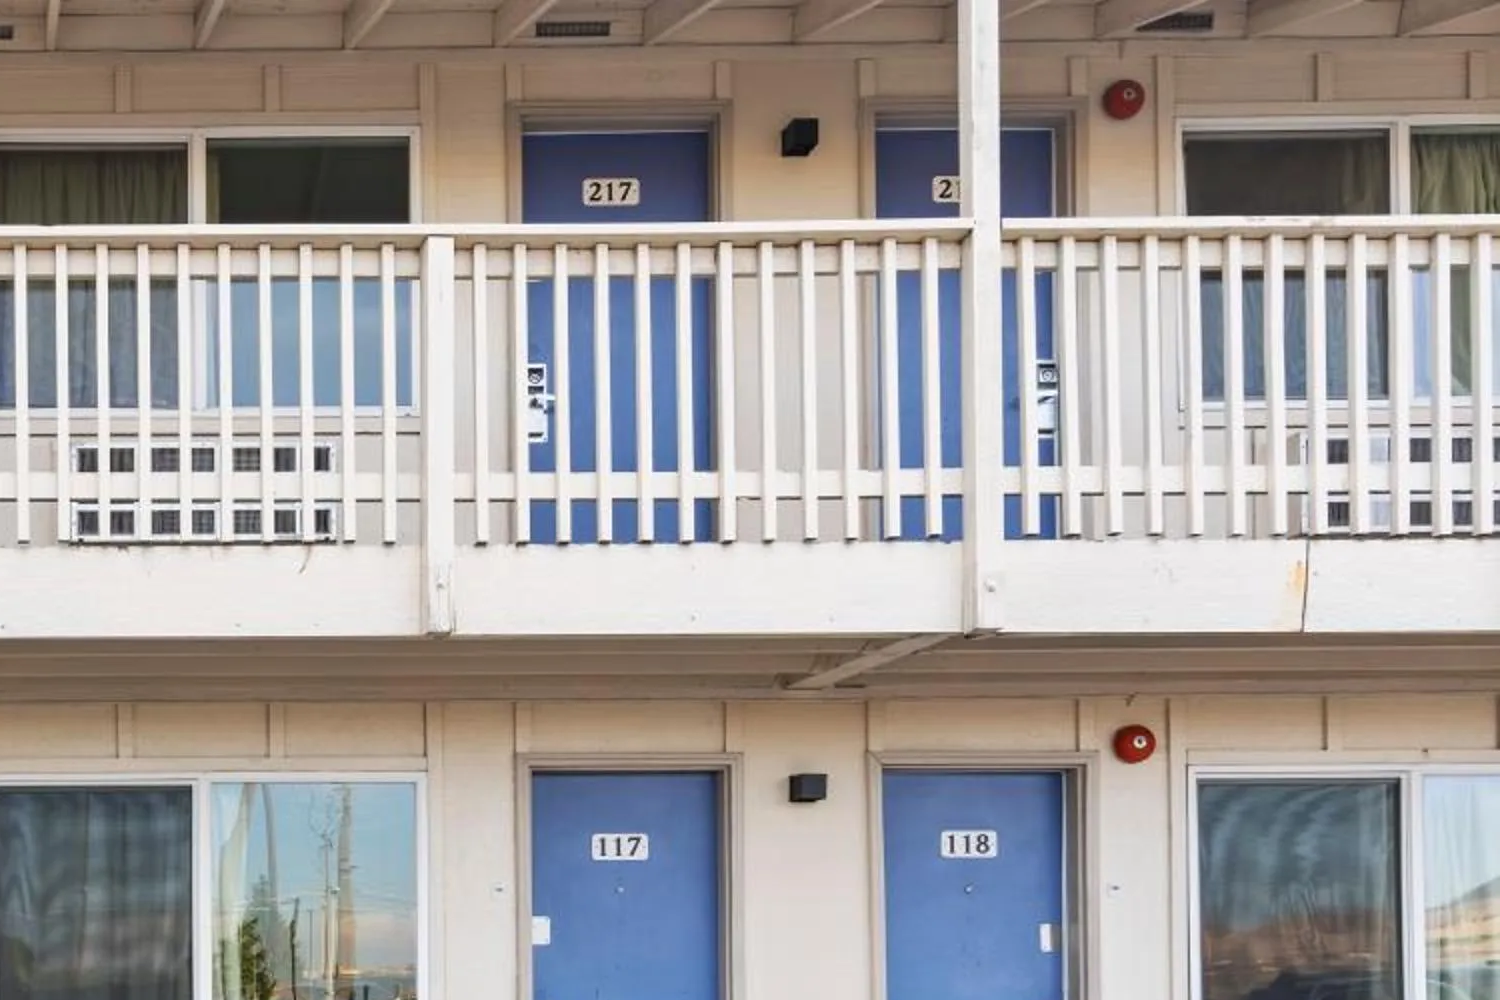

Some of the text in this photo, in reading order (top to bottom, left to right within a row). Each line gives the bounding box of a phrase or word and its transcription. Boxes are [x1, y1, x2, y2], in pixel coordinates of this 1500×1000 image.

[589, 181, 632, 202] 217
[598, 837, 642, 856] 117
[947, 834, 990, 855] 118
